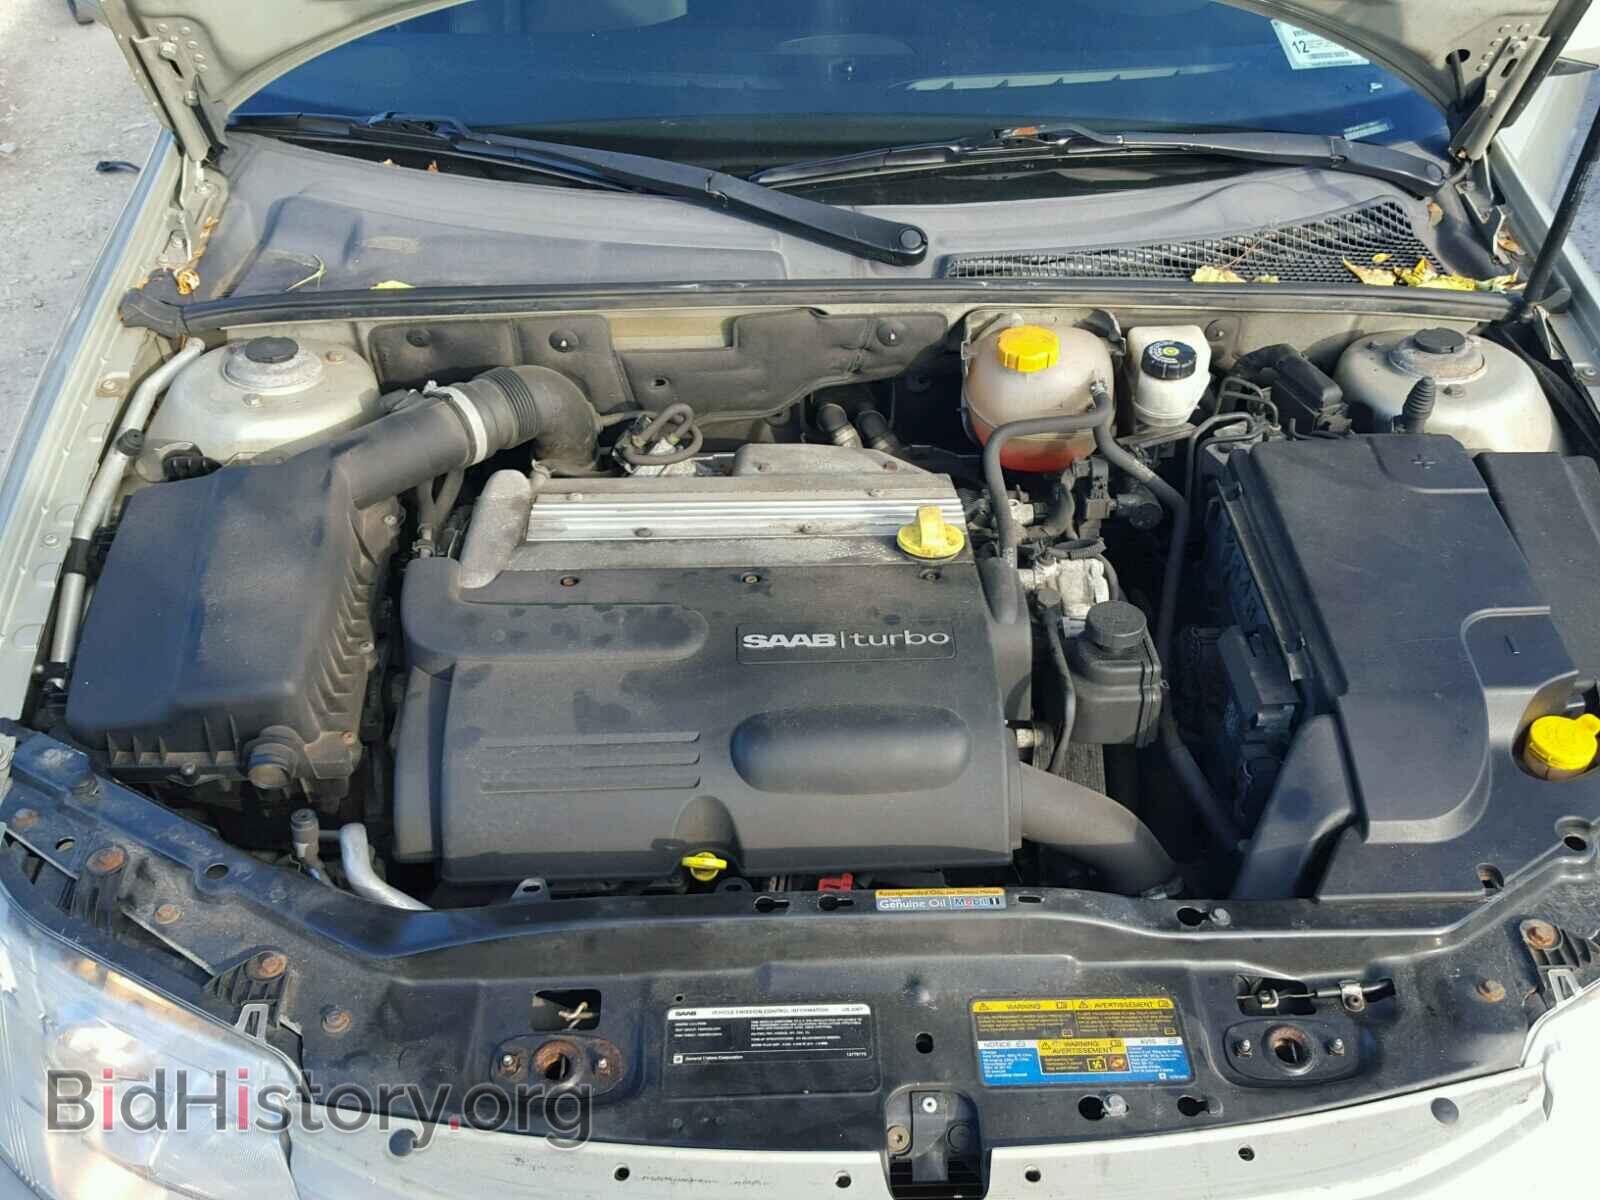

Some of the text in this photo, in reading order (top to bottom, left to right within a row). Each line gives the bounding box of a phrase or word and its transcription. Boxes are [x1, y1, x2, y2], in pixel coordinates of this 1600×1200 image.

[1291, 40, 1310, 54] 12
[743, 630, 949, 648] SAAB turbo
[879, 898, 926, 908] Genuine
[929, 898, 946, 908] Oil
[955, 898, 987, 906] Mobil
